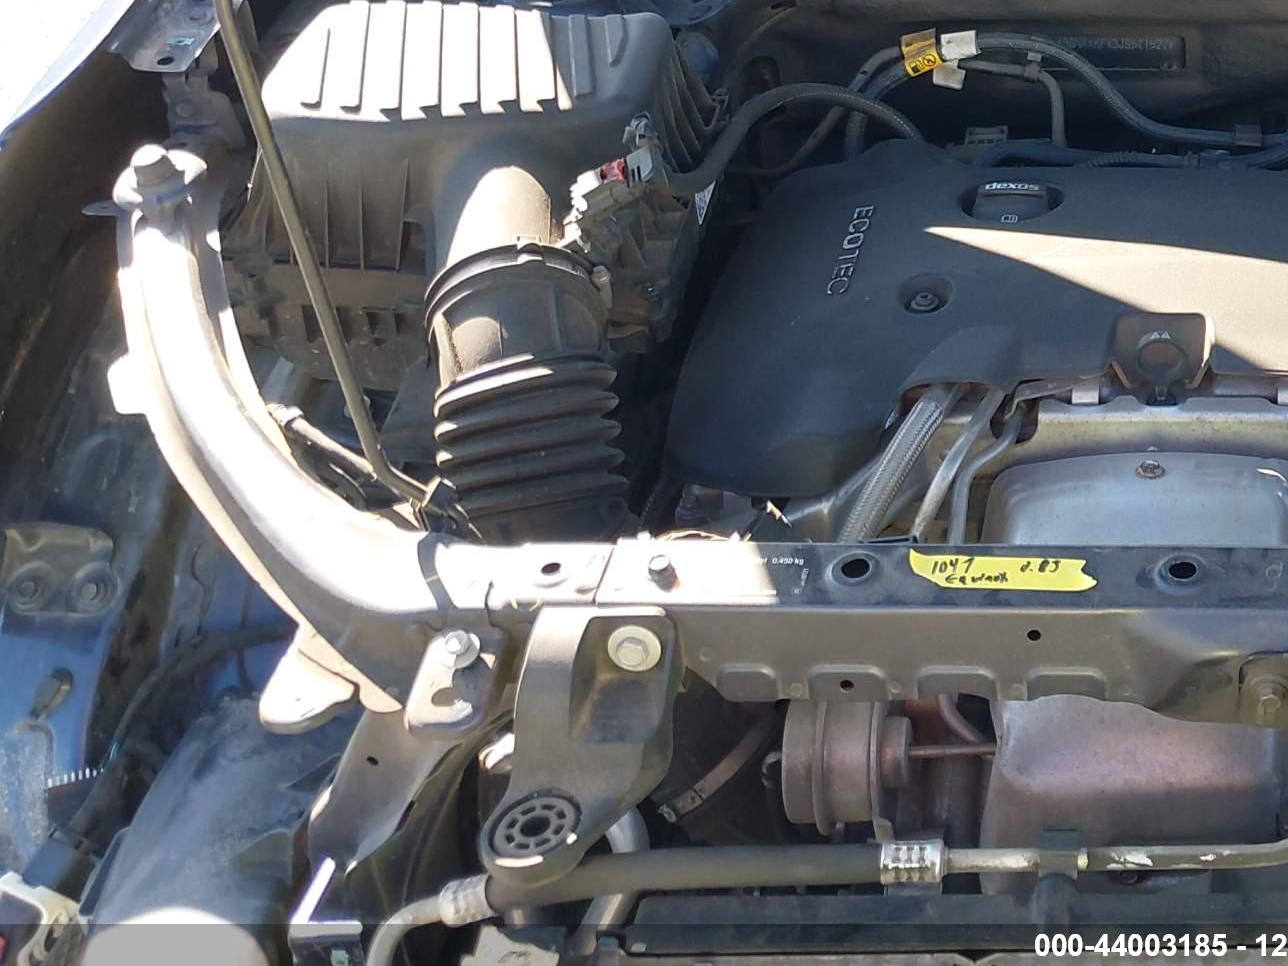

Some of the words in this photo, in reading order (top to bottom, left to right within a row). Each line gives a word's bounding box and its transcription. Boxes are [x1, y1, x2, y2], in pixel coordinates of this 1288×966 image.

[984, 181, 1041, 191] dexos
[826, 204, 875, 295] ECOTEC
[794, 556, 805, 566] kg
